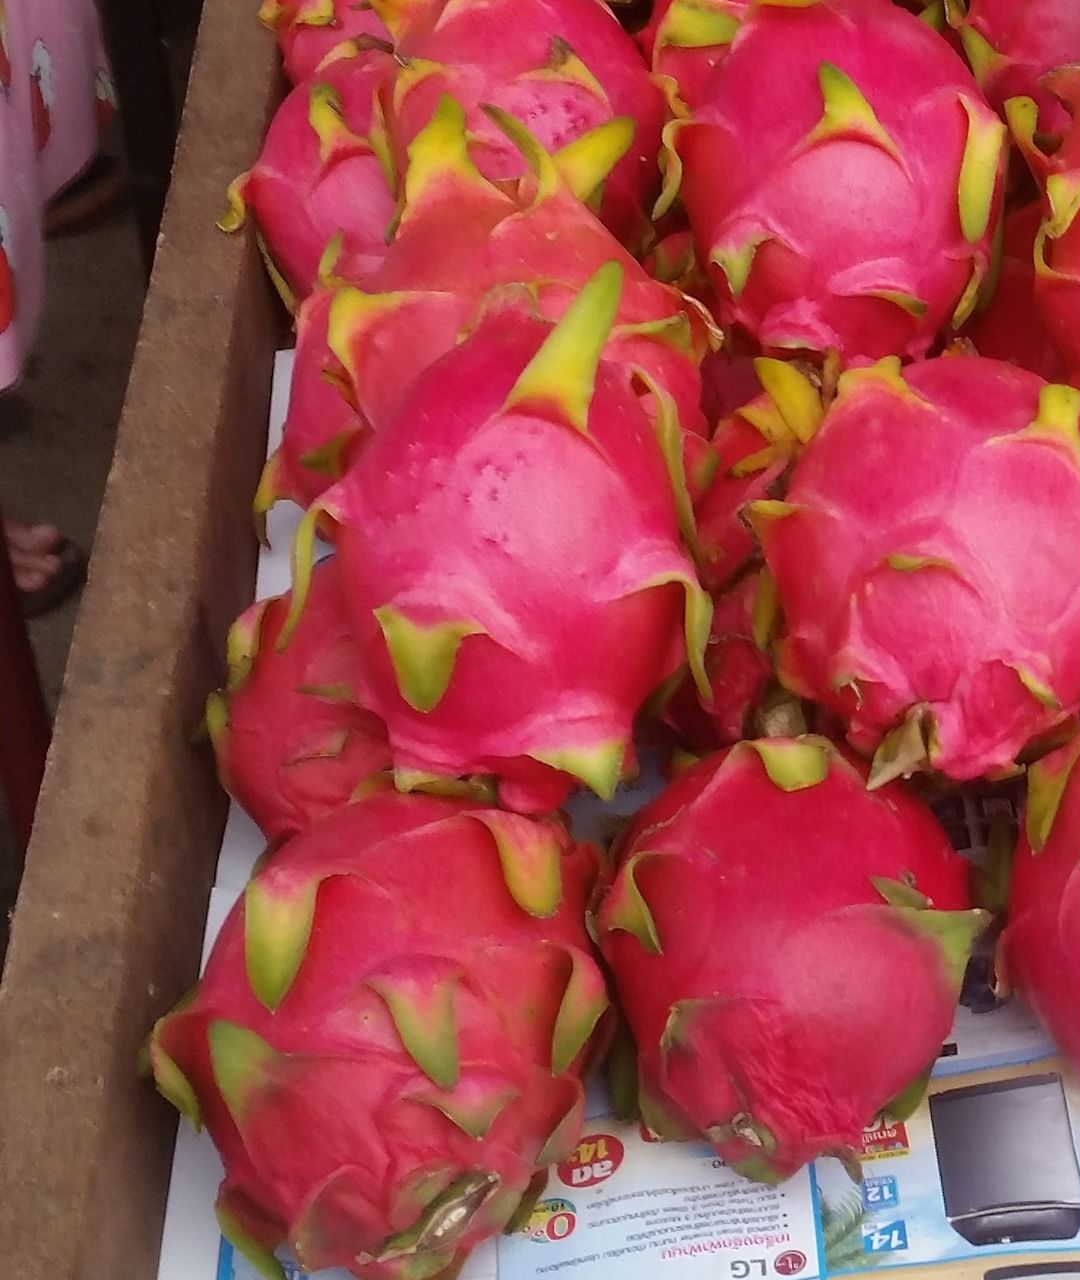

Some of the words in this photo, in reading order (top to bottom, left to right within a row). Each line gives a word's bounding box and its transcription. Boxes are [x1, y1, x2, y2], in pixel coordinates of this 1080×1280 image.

[571, 1159, 613, 1185] ลด
[866, 1185, 894, 1202] 12
[869, 1229, 905, 1252] 14
[729, 1258, 767, 1279] LG
